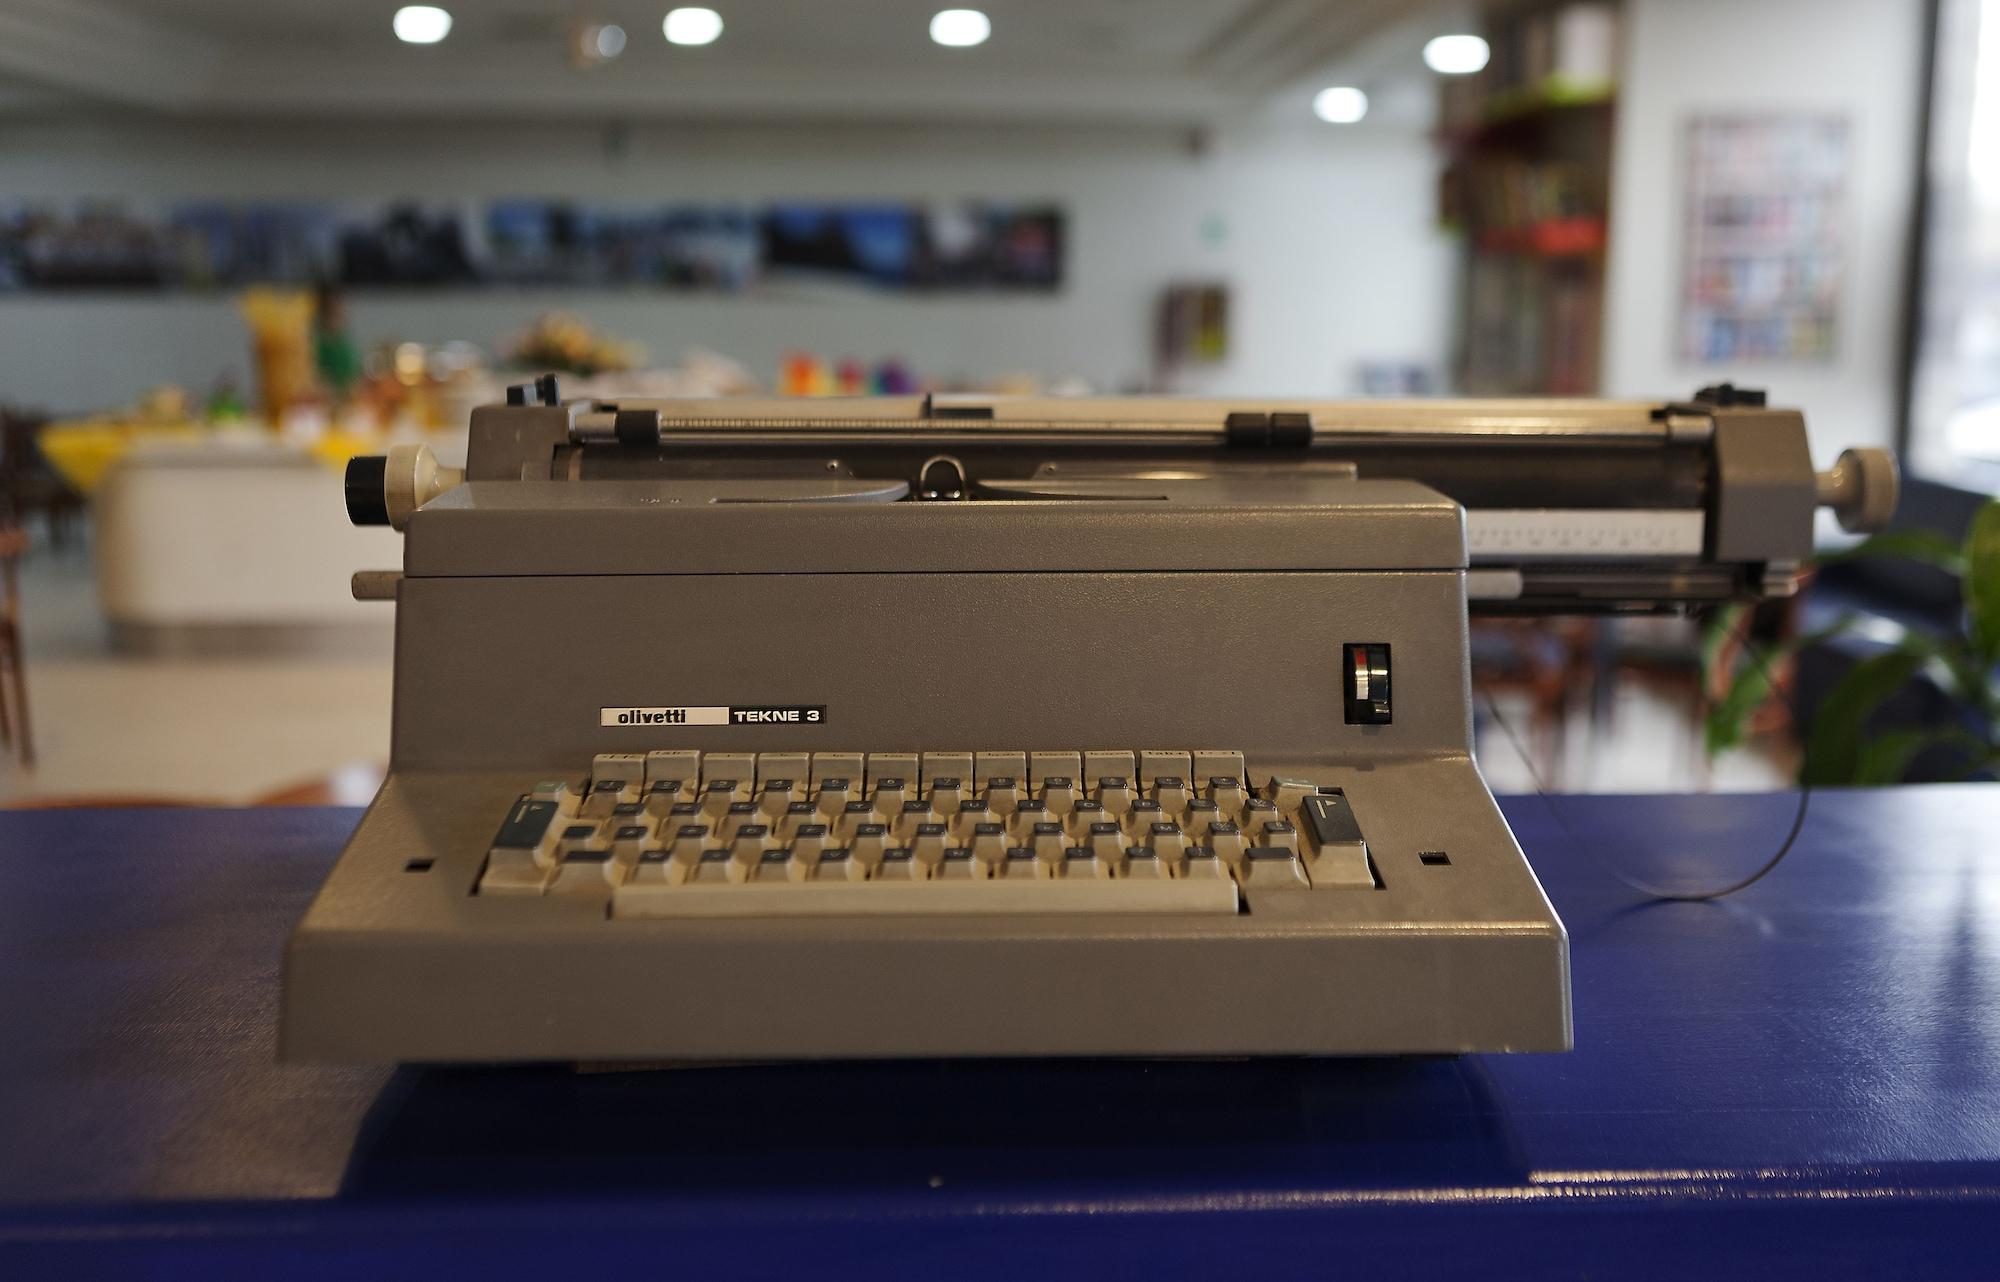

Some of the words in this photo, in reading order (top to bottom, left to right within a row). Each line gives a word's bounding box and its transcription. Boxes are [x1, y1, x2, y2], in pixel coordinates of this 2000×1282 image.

[617, 709, 686, 724] olivetti
[734, 710, 799, 723] TEKNE
[806, 710, 820, 722] 3
